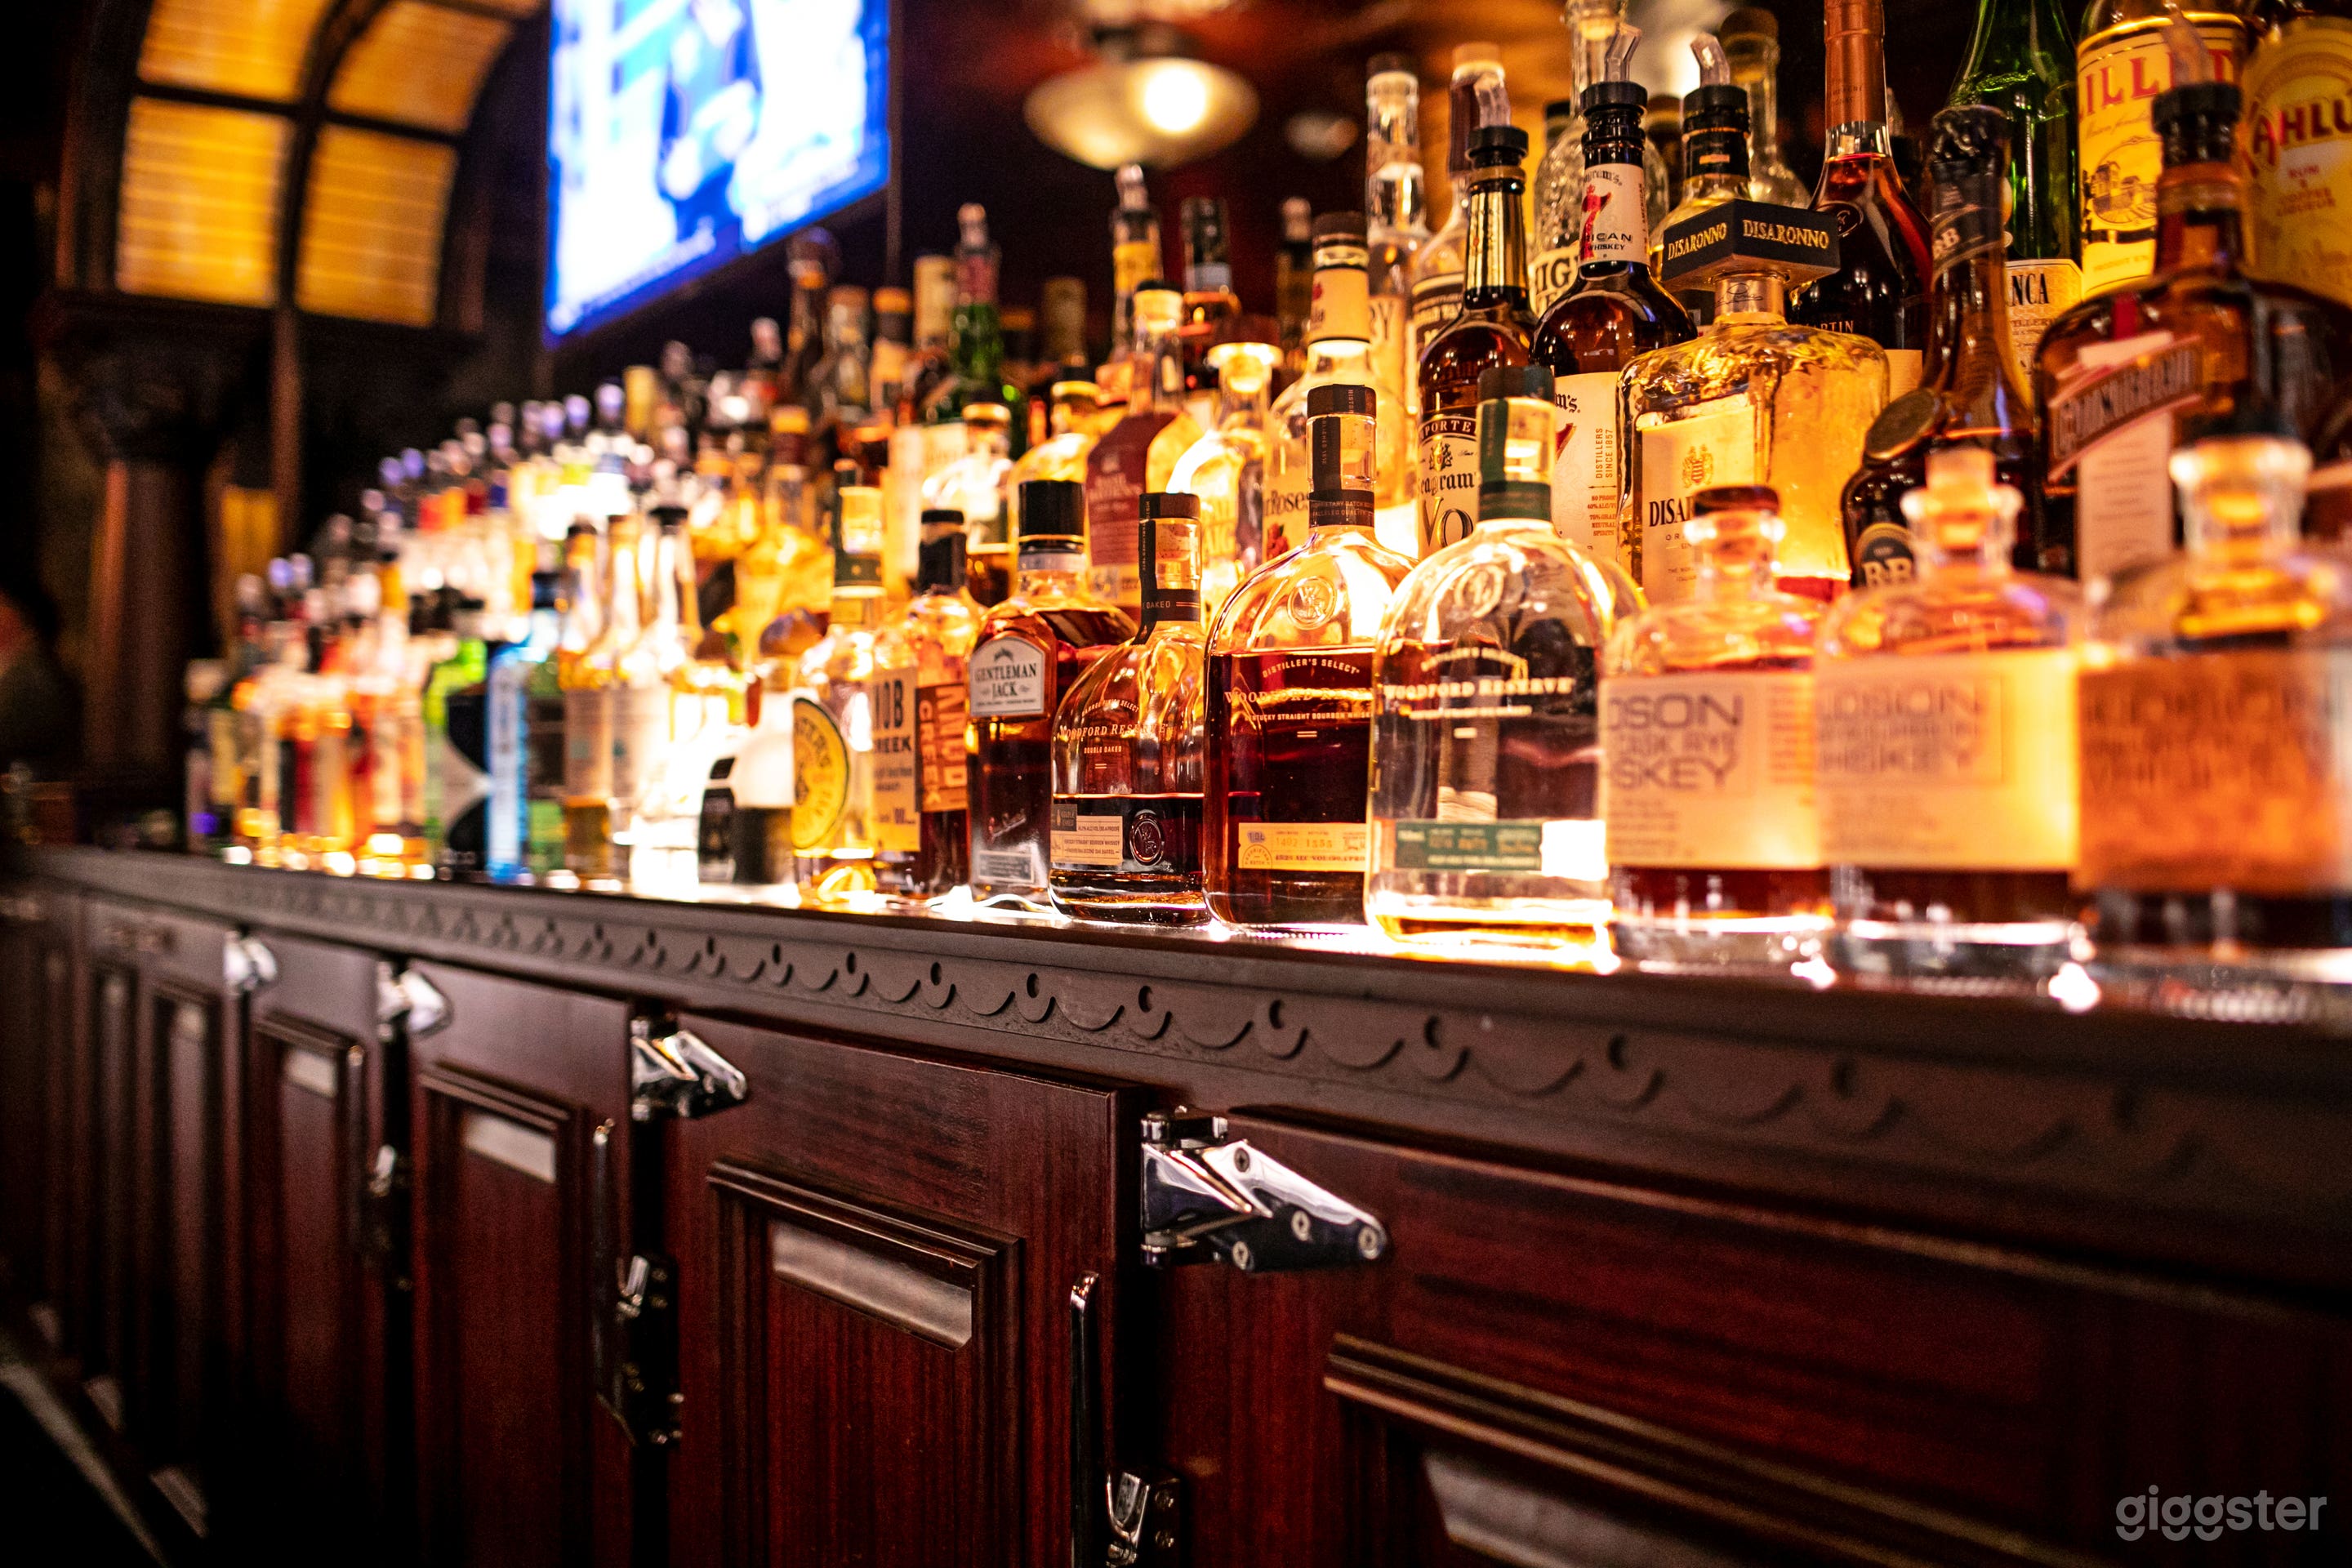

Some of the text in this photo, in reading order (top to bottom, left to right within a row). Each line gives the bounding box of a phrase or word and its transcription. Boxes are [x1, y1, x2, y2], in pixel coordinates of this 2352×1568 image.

[2078, 50, 2234, 121] ILLT
[1668, 222, 1727, 261] DISARONNO
[1742, 219, 1830, 249] DISARONNO
[1422, 420, 1477, 439] PORTE
[1595, 428, 1603, 479] DISTILLERS
[1605, 429, 1613, 478] SINCE 1857
[1147, 600, 1171, 609] OAKED
[975, 663, 1036, 683] GENTLEMAN
[1263, 658, 1359, 678] DISTILLER'S SELECT
[992, 681, 1018, 700] JACK
[1120, 700, 1139, 713] SELECT
[1277, 712, 1310, 720] STRAIGHT
[1312, 711, 1345, 719] BOURBON
